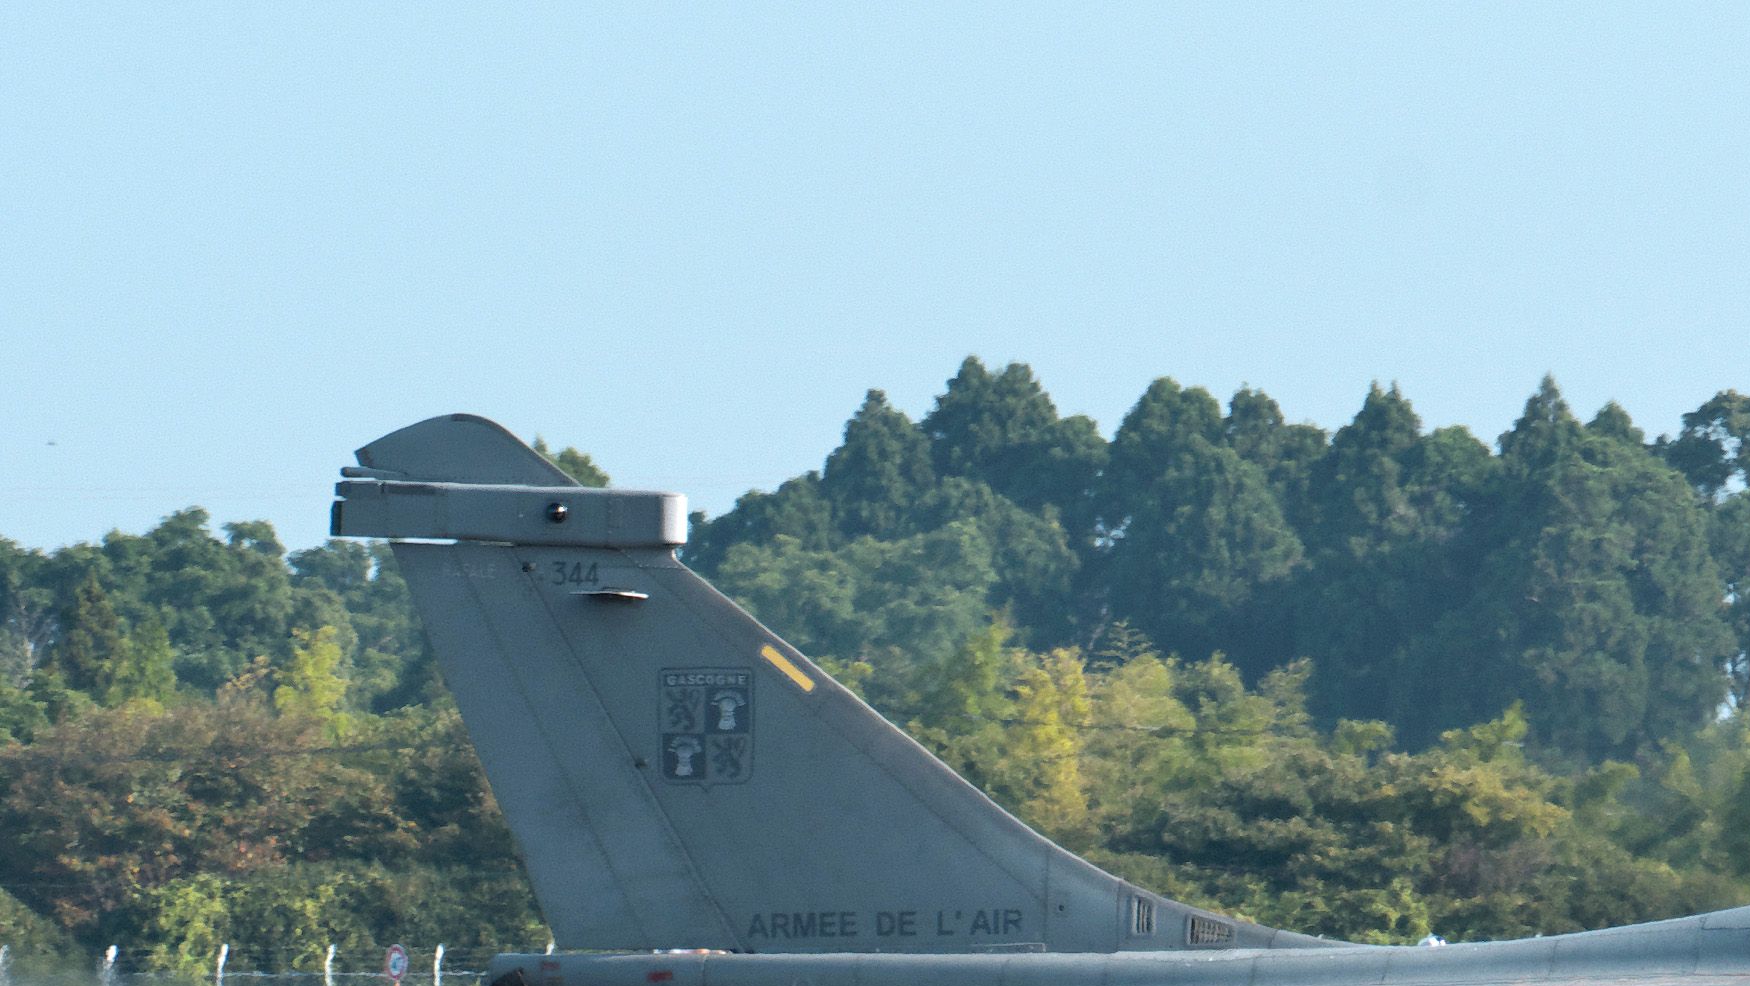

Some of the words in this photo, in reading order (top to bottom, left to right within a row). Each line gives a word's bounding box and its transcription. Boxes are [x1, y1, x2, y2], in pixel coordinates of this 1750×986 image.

[551, 560, 600, 587] 344
[665, 674, 747, 687] GASCOGNE
[749, 911, 858, 939] ARMEE
[876, 910, 918, 937] DE
[936, 908, 1024, 936] L'AIR
